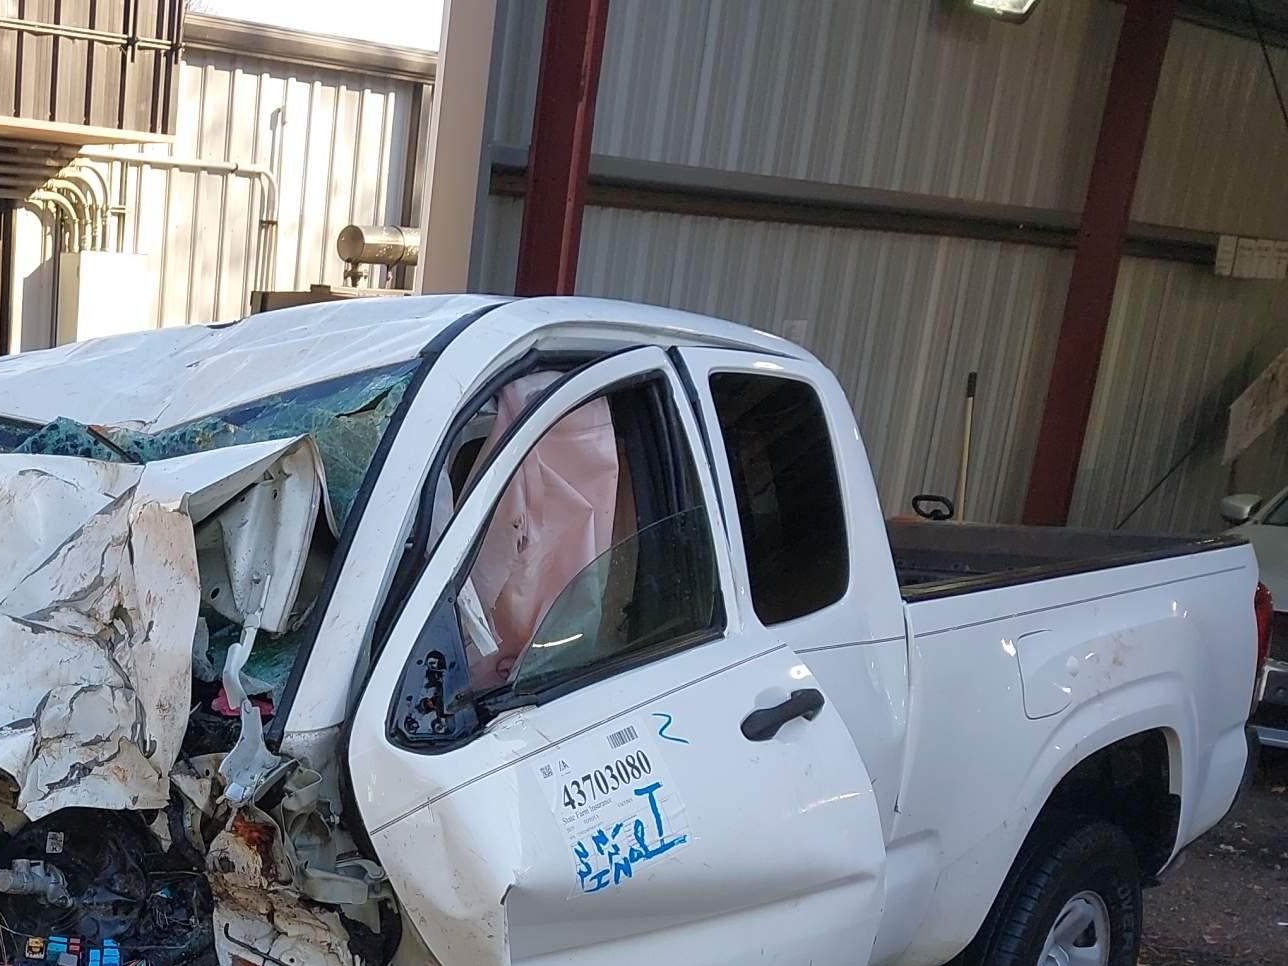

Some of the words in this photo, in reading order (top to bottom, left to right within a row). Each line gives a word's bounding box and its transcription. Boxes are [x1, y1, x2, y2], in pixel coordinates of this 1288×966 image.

[563, 750, 651, 809] 43703080
[562, 813, 575, 825] State
[575, 807, 589, 819] Farm
[588, 798, 612, 811] Insurance
